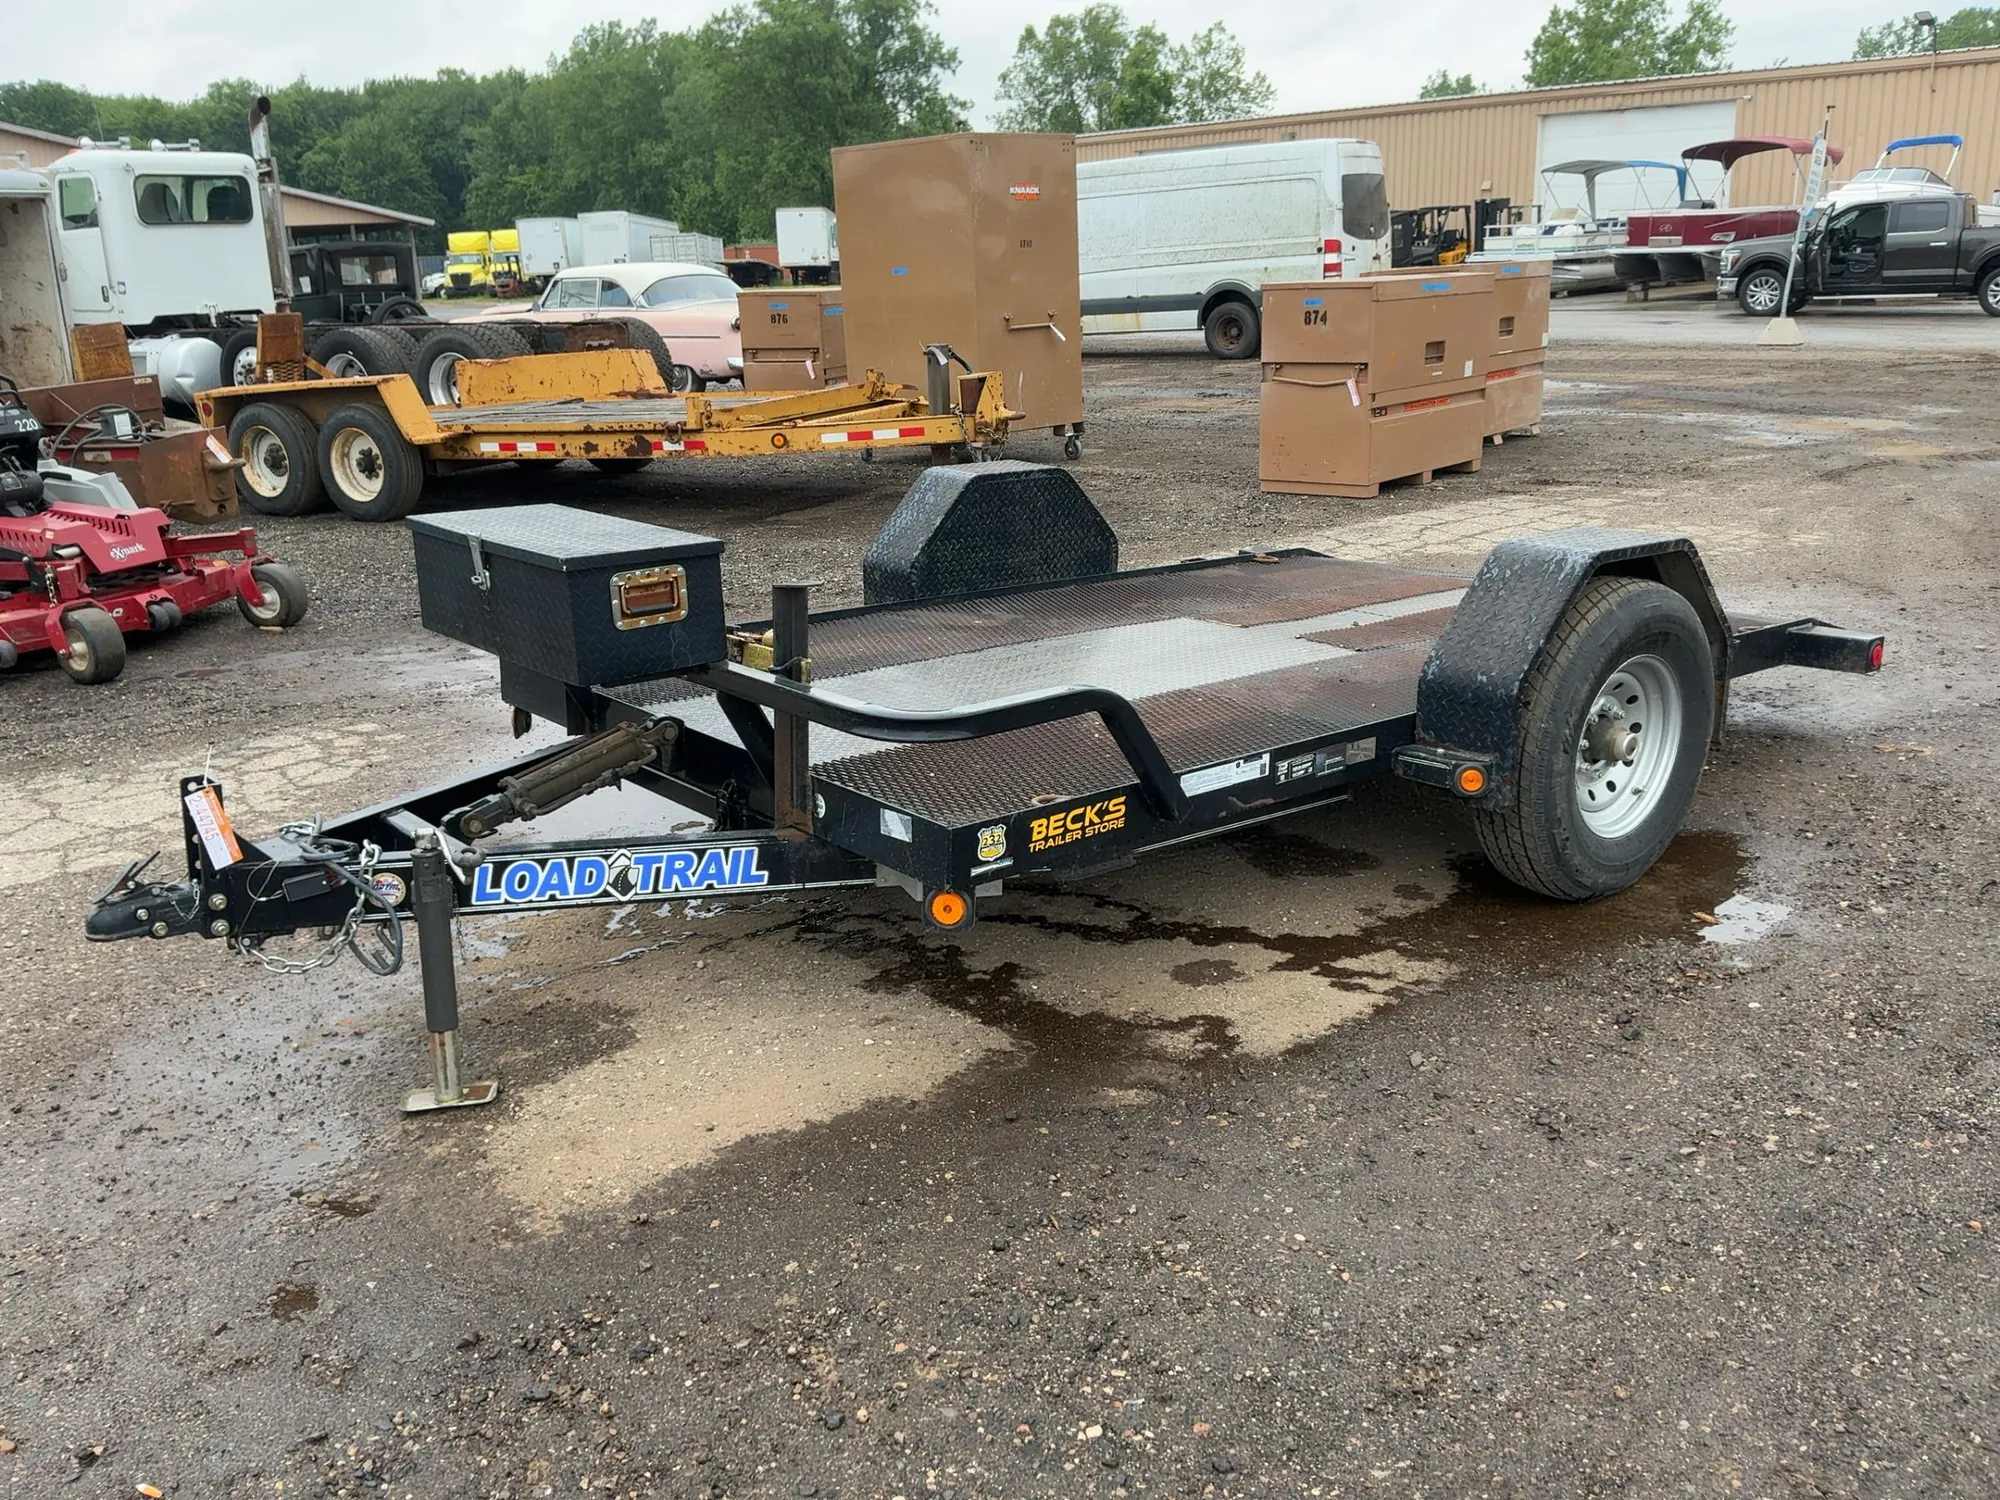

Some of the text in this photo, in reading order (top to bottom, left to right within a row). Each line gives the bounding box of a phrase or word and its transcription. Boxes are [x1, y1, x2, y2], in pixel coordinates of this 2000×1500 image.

[1008, 186, 1041, 195] KNAACK
[770, 313, 789, 325] 876
[1304, 309, 1328, 326] 874
[14, 418, 39, 432] 220
[1029, 796, 1127, 842] BECK'S
[983, 834, 1001, 846] 232
[1028, 817, 1126, 853] TRAILER STORE
[471, 847, 769, 905] LOAD TRAIL
